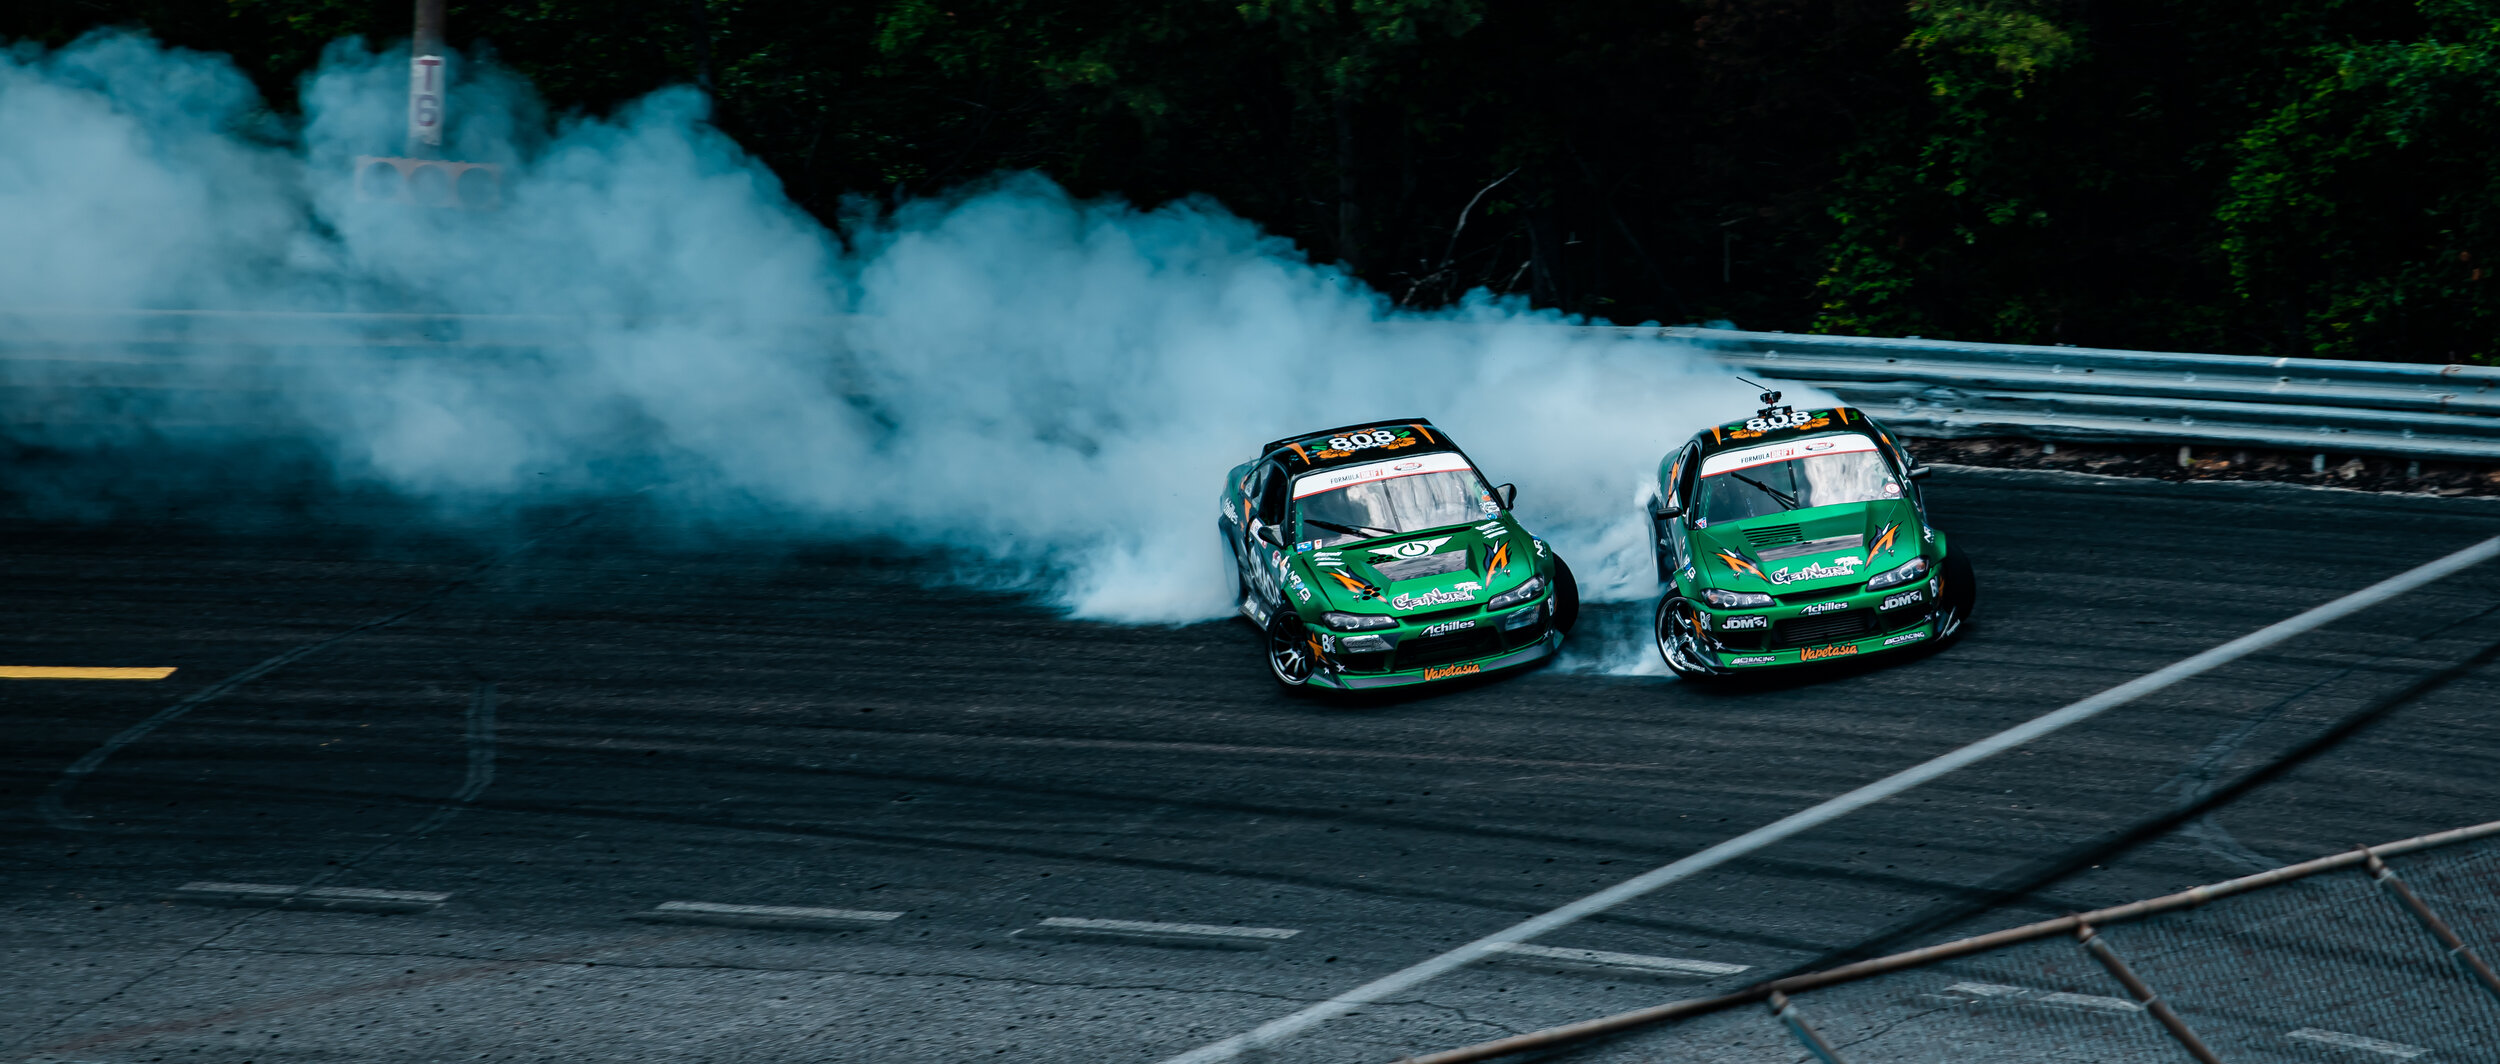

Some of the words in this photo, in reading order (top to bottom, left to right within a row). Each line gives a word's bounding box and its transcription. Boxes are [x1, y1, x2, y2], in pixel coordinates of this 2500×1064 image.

[1746, 411, 1811, 431] 808
[1328, 430, 1396, 450] 808
[1741, 452, 1770, 464] FORMULA
[1330, 474, 1360, 485] FORMULA
[1800, 602, 1848, 614] Achilles
[1421, 620, 1475, 636] Achilles
[1900, 631, 1925, 641] RACING
[1800, 642, 1858, 661] Vapetasia
[1424, 661, 1480, 681] Vapetasia
